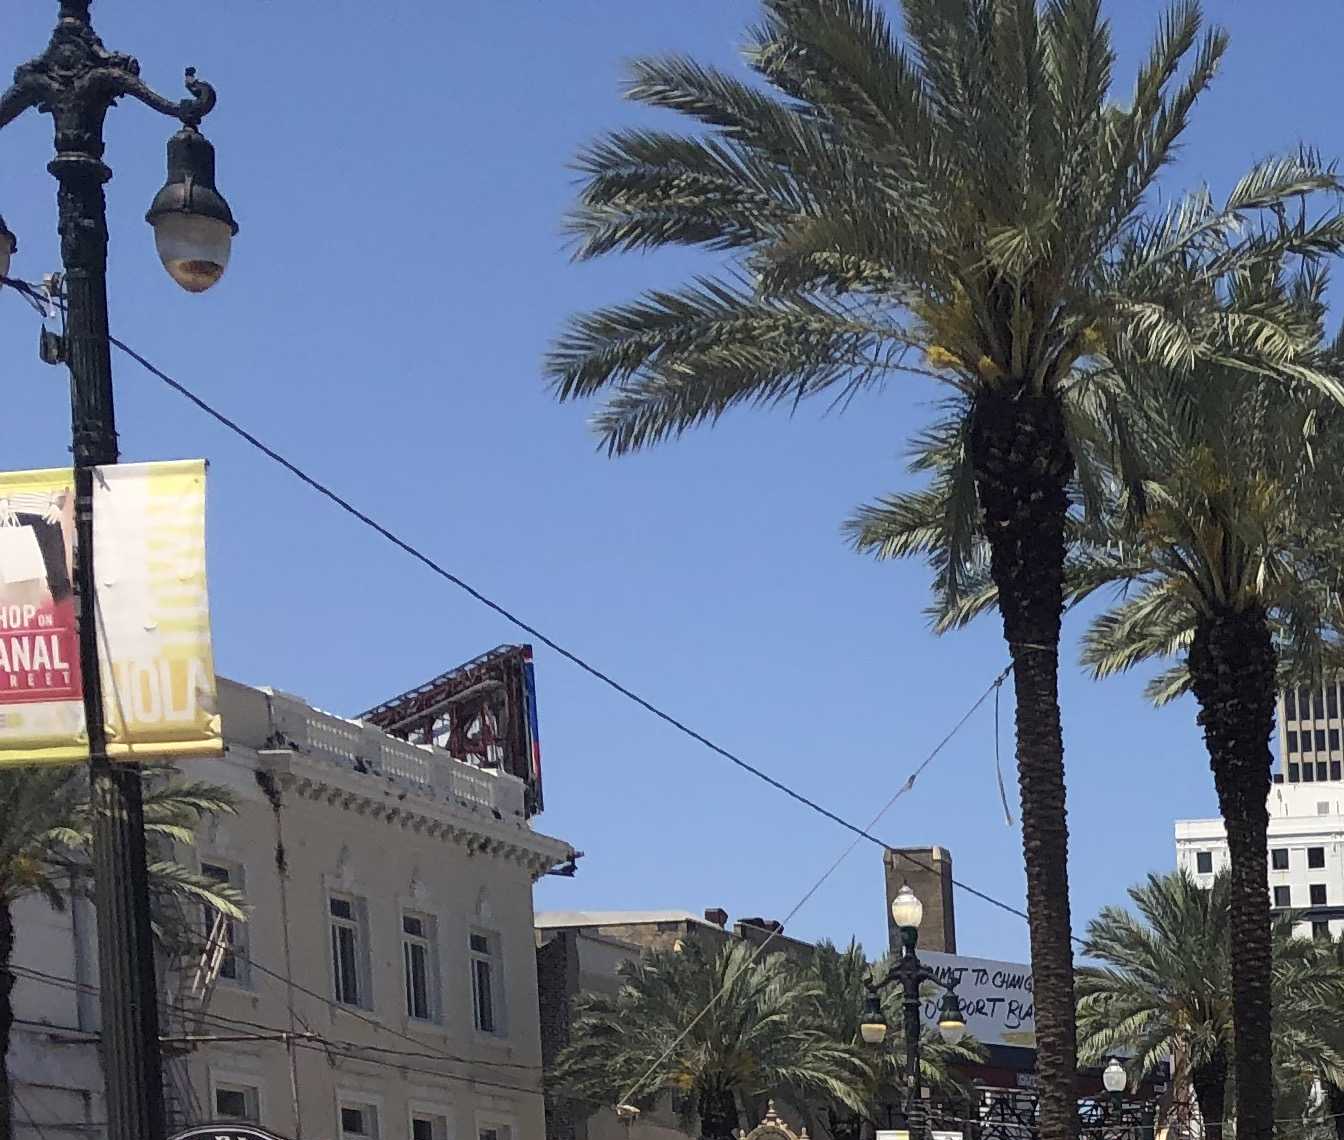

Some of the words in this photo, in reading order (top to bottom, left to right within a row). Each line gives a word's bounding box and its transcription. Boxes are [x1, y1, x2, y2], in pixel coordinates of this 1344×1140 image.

[0, 603, 37, 629] HOP
[38, 614, 54, 627] ON
[0, 634, 69, 673] ANAL
[9, 671, 72, 688] REET
[972, 968, 989, 986] TO
[992, 969, 1033, 993] CHANG
[1004, 999, 1033, 1030] BLA
